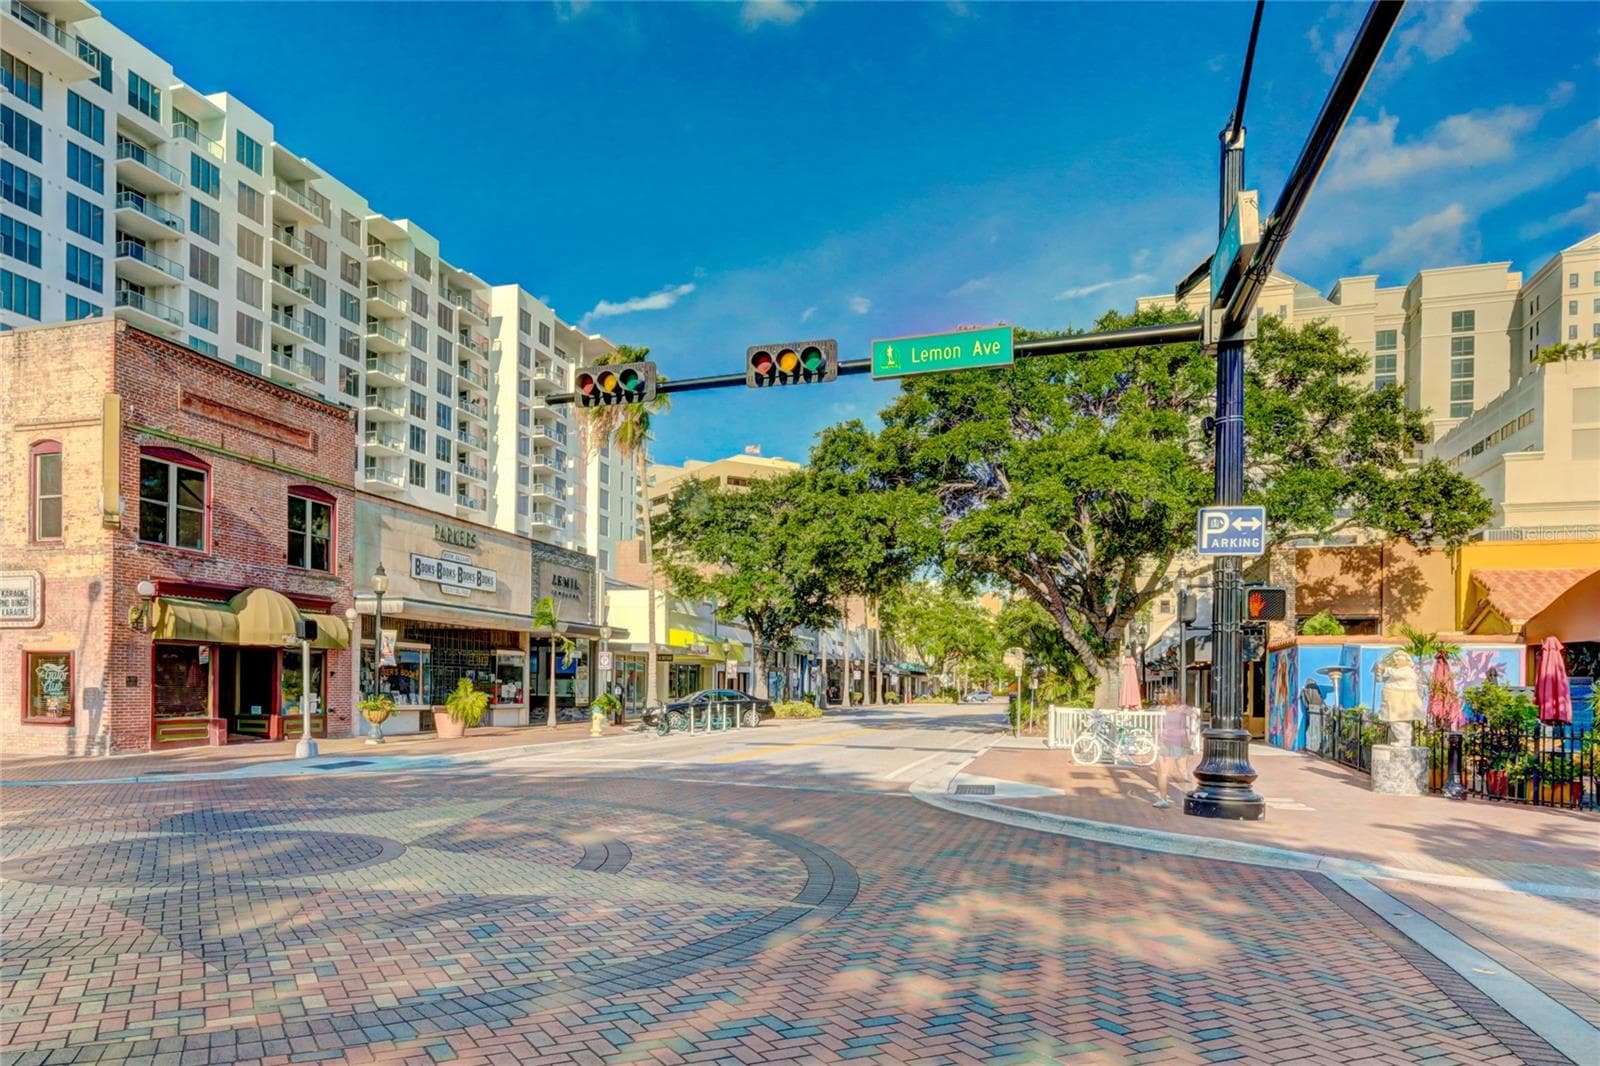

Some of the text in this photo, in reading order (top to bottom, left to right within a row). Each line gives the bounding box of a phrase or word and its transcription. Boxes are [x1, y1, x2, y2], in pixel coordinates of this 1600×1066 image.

[911, 340, 1001, 364] Lemon Ave
[1201, 511, 1260, 549] PARKING
[1, 589, 28, 598] KARAOKE
[1, 608, 28, 616] KARAOKE
